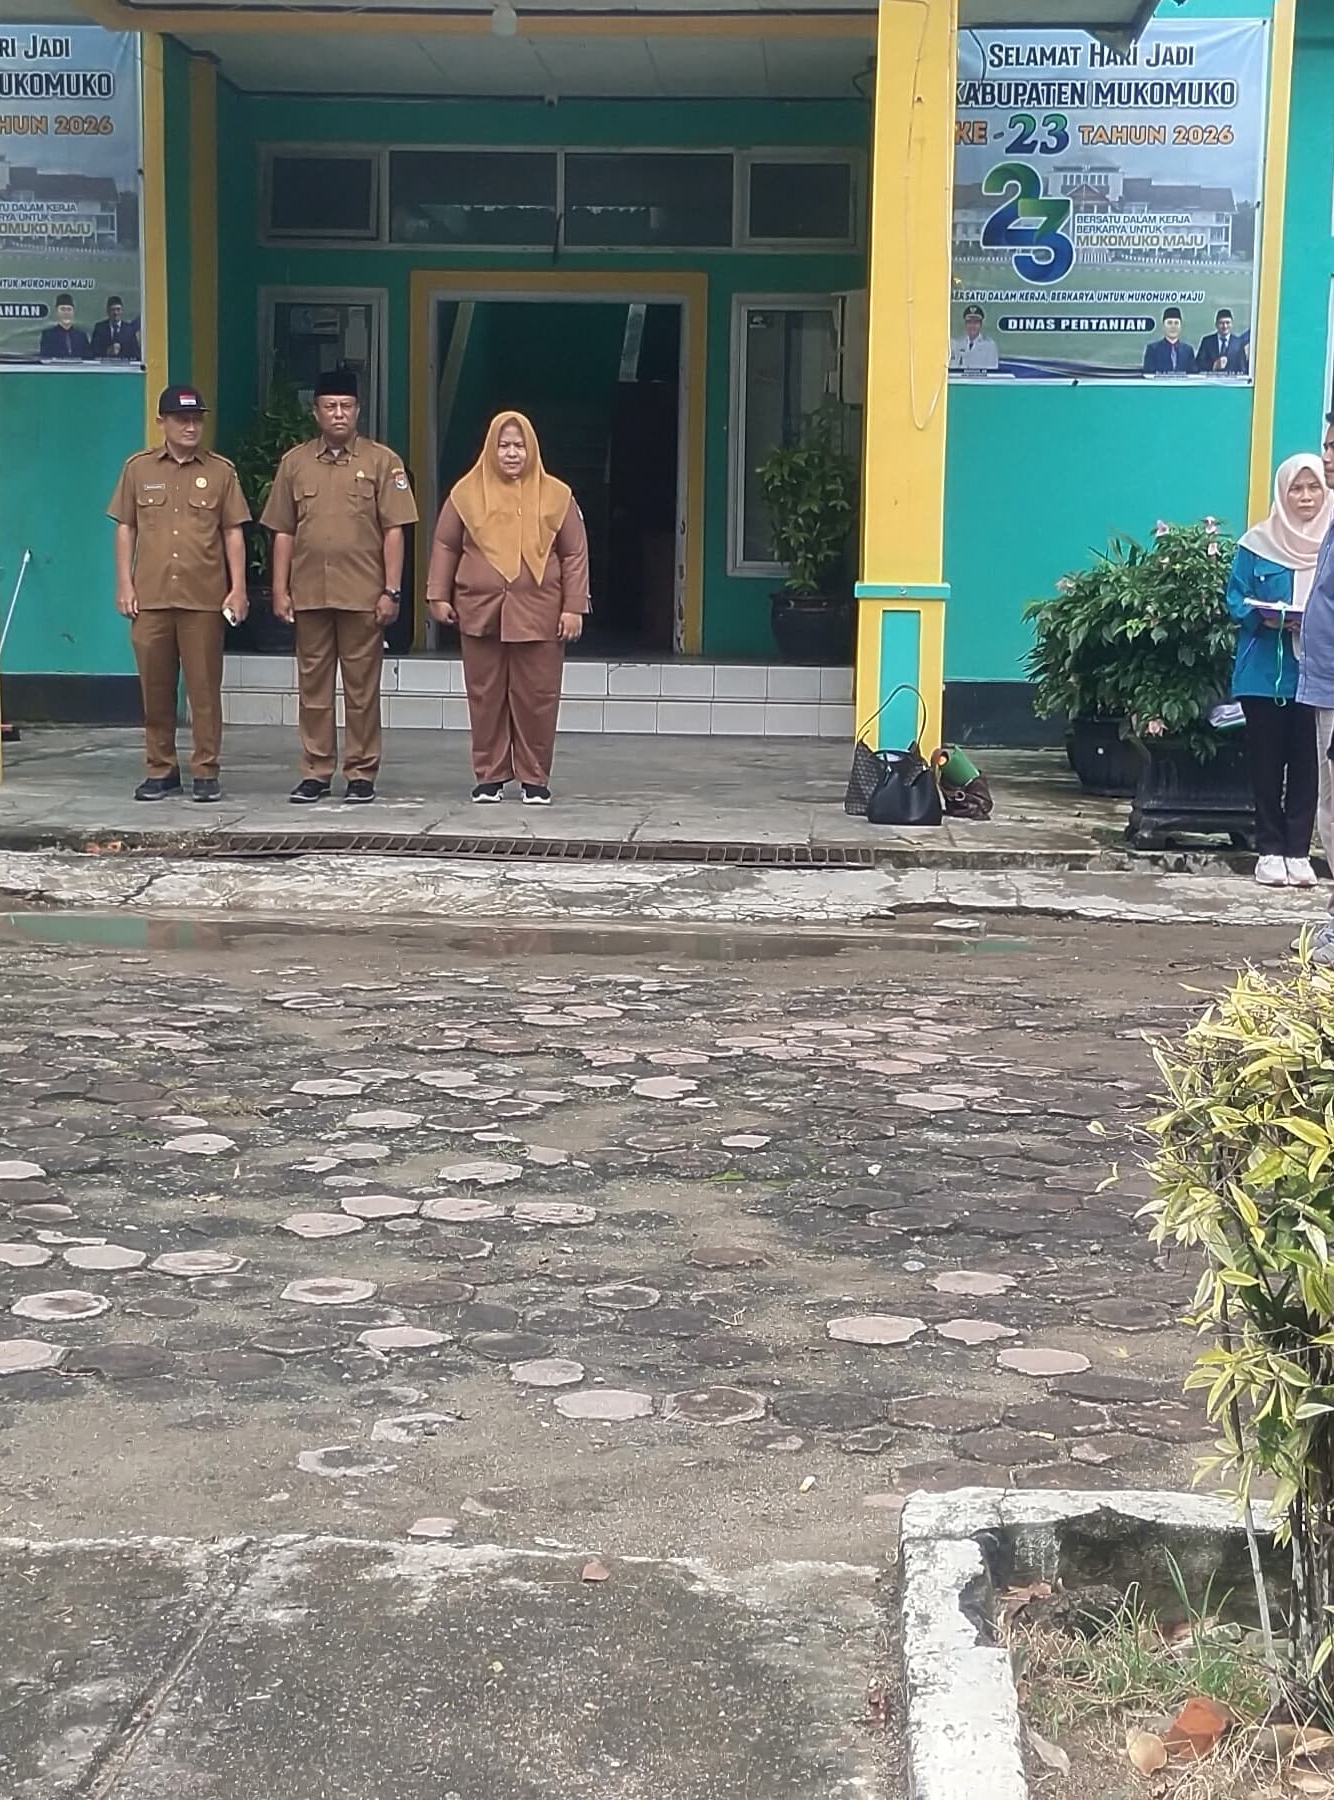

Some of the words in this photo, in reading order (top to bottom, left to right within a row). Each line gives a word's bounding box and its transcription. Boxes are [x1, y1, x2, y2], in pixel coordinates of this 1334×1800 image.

[23, 34, 71, 59] JADI
[988, 43, 1082, 68] SELAMAT
[1145, 42, 1195, 67] JADI
[1093, 81, 1237, 107] MUKOMUKO
[54, 114, 114, 135] 2026
[955, 120, 988, 146] KE
[1078, 124, 1167, 146] TAHUN
[1171, 124, 1235, 146] 2026
[12, 202, 44, 212] DALAM
[46, 202, 77, 212] KERJA
[18, 213, 51, 222] UNTUK
[1076, 215, 1121, 224] BERSATU
[1123, 215, 1157, 224] DALAM
[1159, 215, 1191, 224] KERJA
[50, 223, 91, 235] MAJU
[1076, 225, 1127, 234] BERKARYA
[1129, 225, 1163, 234] UNTUK
[1076, 235, 1159, 247] MUKOMUKO
[1162, 235, 1205, 247] MAJU
[20, 279, 68, 289] MUKOMUKO
[71, 279, 94, 289] MAJU
[952, 291, 986, 301] ERSATU
[988, 291, 1017, 301] DALAM
[1051, 291, 1095, 301] BERKARYA
[1097, 291, 1126, 301] UNTUK
[1128, 291, 1178, 301] MUKOMUKO
[1179, 291, 1205, 301] MAJU
[1008, 318, 1056, 330] DINAS
[1060, 318, 1147, 331] PERTANIAN
